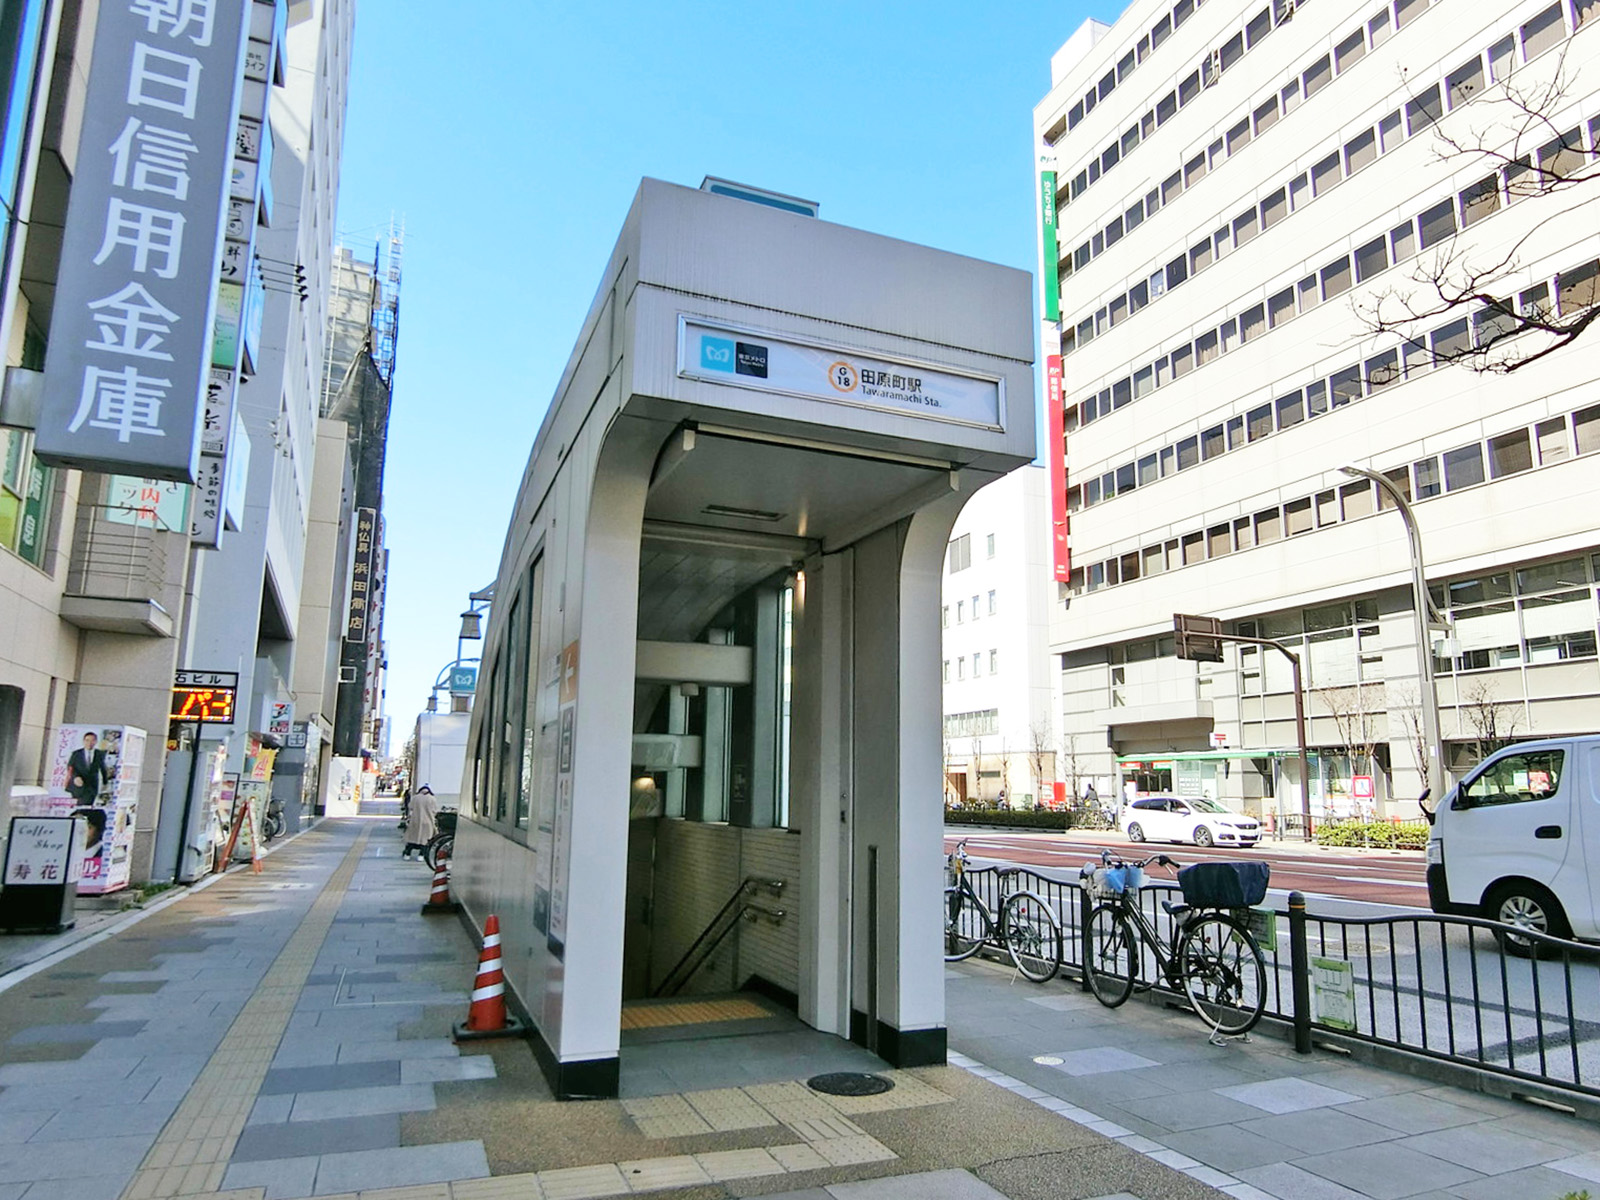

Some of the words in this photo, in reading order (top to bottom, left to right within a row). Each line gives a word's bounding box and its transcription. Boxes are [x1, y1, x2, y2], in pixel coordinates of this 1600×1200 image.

[67, 0, 216, 443] 朝日信用金庫
[738, 353, 766, 363] 東京メトロ
[839, 367, 847, 376] G
[837, 376, 850, 387] 18
[861, 369, 922, 393] 田原町駅
[862, 385, 922, 404] Tawaramachi
[924, 396, 942, 408] Sta.
[358, 522, 371, 553] 神仏具
[350, 563, 368, 629] 浜田商店
[19, 825, 54, 836] Coffee
[34, 839, 63, 851] Shop
